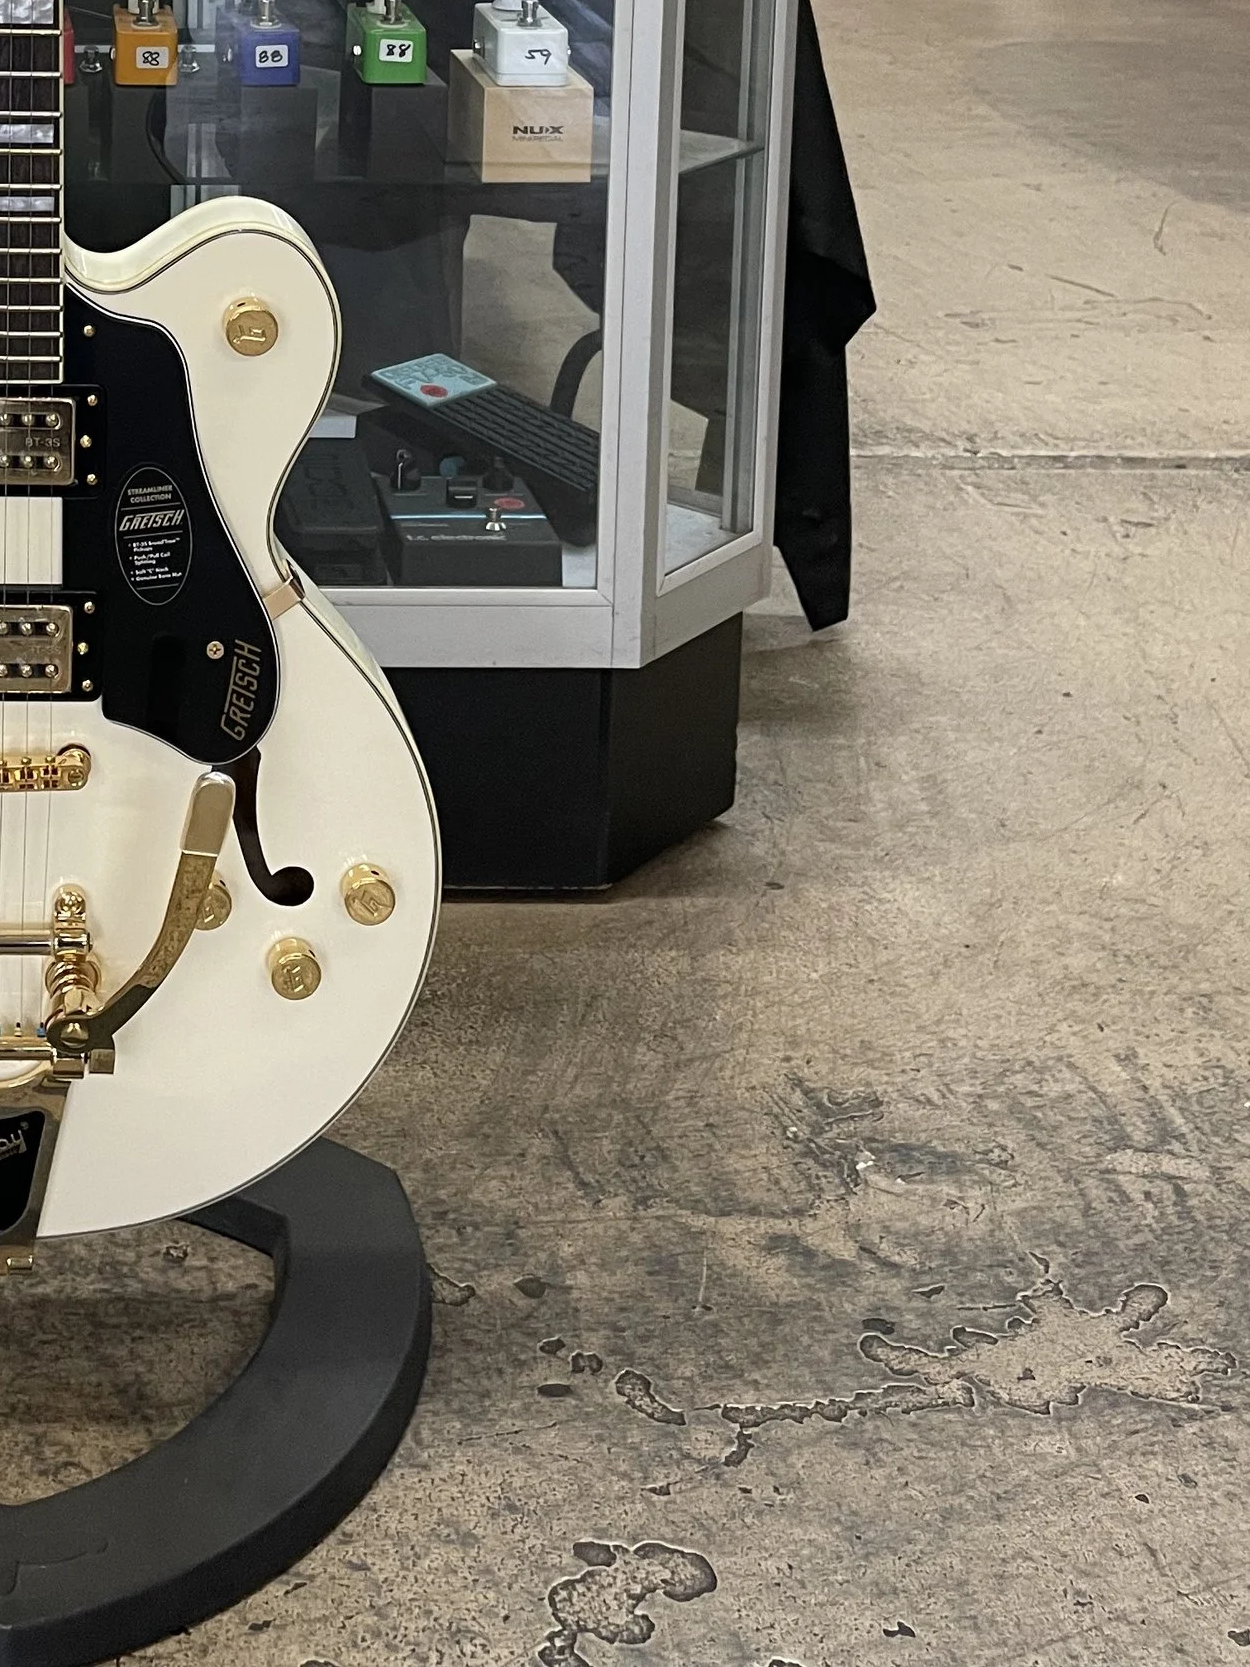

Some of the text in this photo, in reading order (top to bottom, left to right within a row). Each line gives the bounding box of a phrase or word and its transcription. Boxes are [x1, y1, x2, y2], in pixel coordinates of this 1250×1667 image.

[142, 50, 161, 66] 88
[524, 48, 552, 66] 59
[25, 437, 61, 448] BT-3S
[127, 484, 173, 496] STREAMLINER
[130, 493, 172, 504] COLLECTION
[119, 509, 185, 532] GRETSCH
[220, 638, 262, 742] GRETSCH
